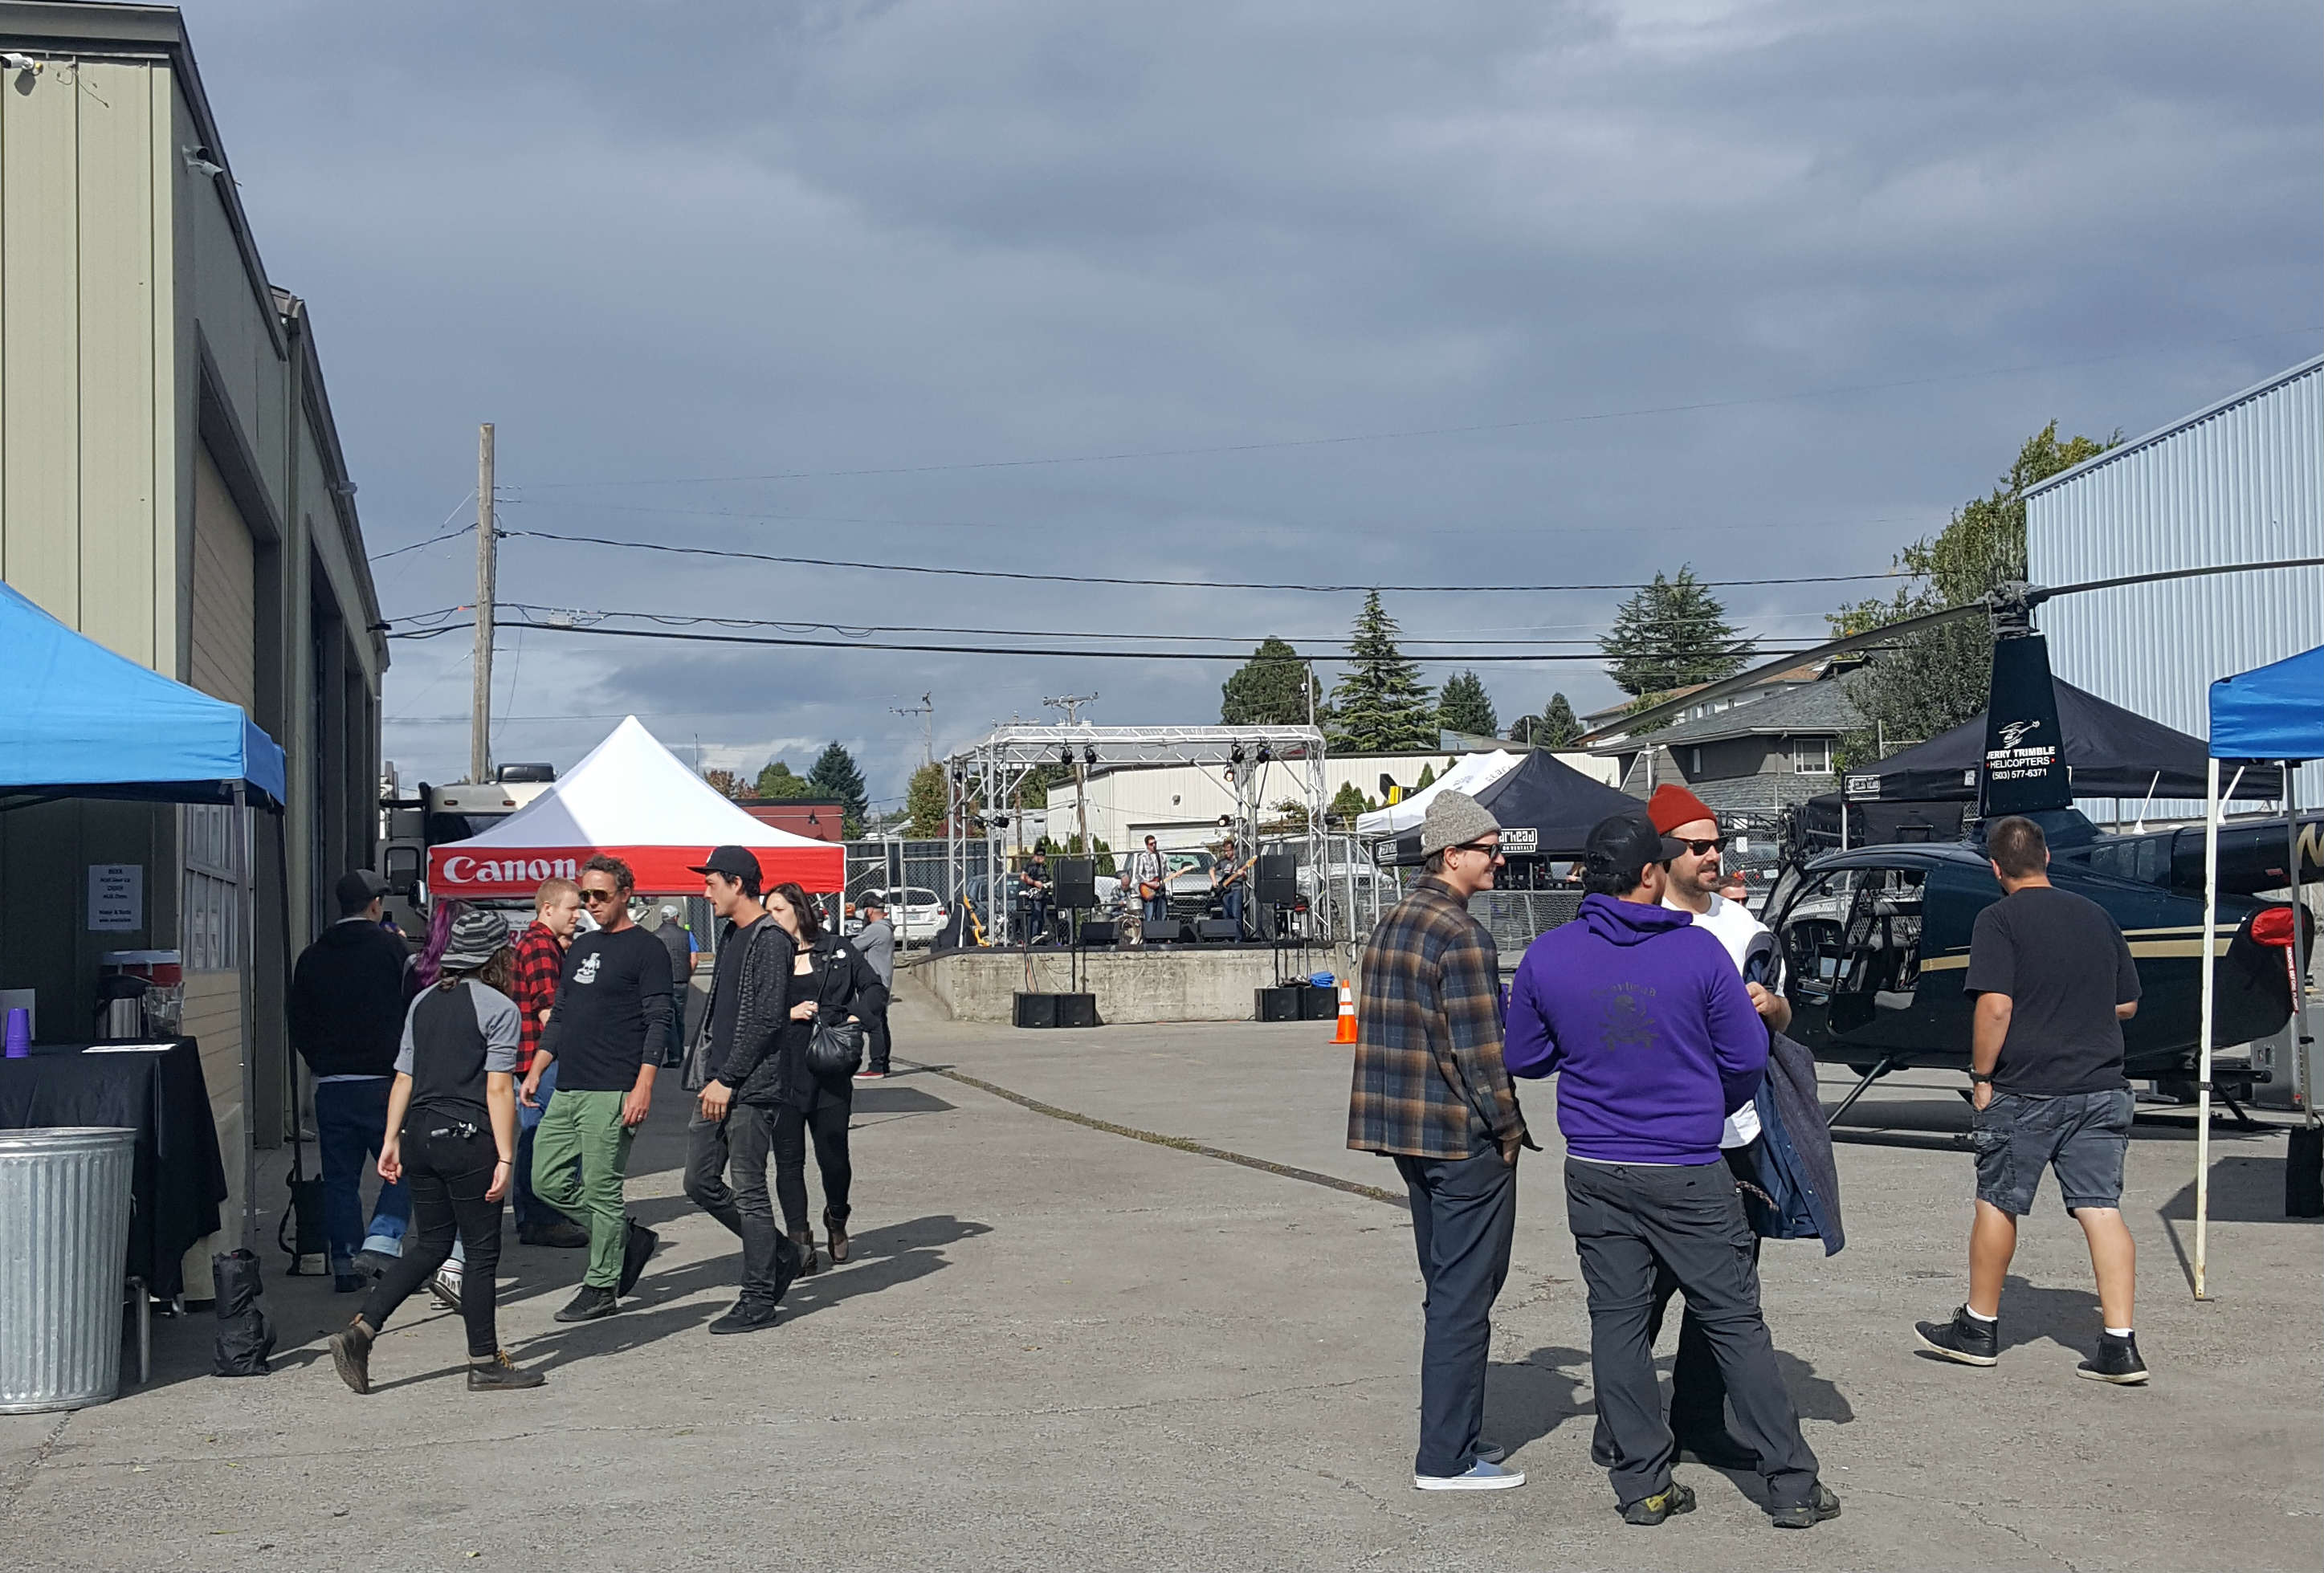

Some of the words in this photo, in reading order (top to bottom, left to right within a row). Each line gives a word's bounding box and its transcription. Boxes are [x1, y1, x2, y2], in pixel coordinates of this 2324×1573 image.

[1986, 749, 2011, 760] JERRY
[2013, 746, 2056, 757] TRIMBLE
[1990, 756, 2050, 769] HELICOPTERS
[1992, 770, 2010, 780] (503)
[2011, 768, 2047, 779] 577-6371
[443, 856, 576, 883] Canon
